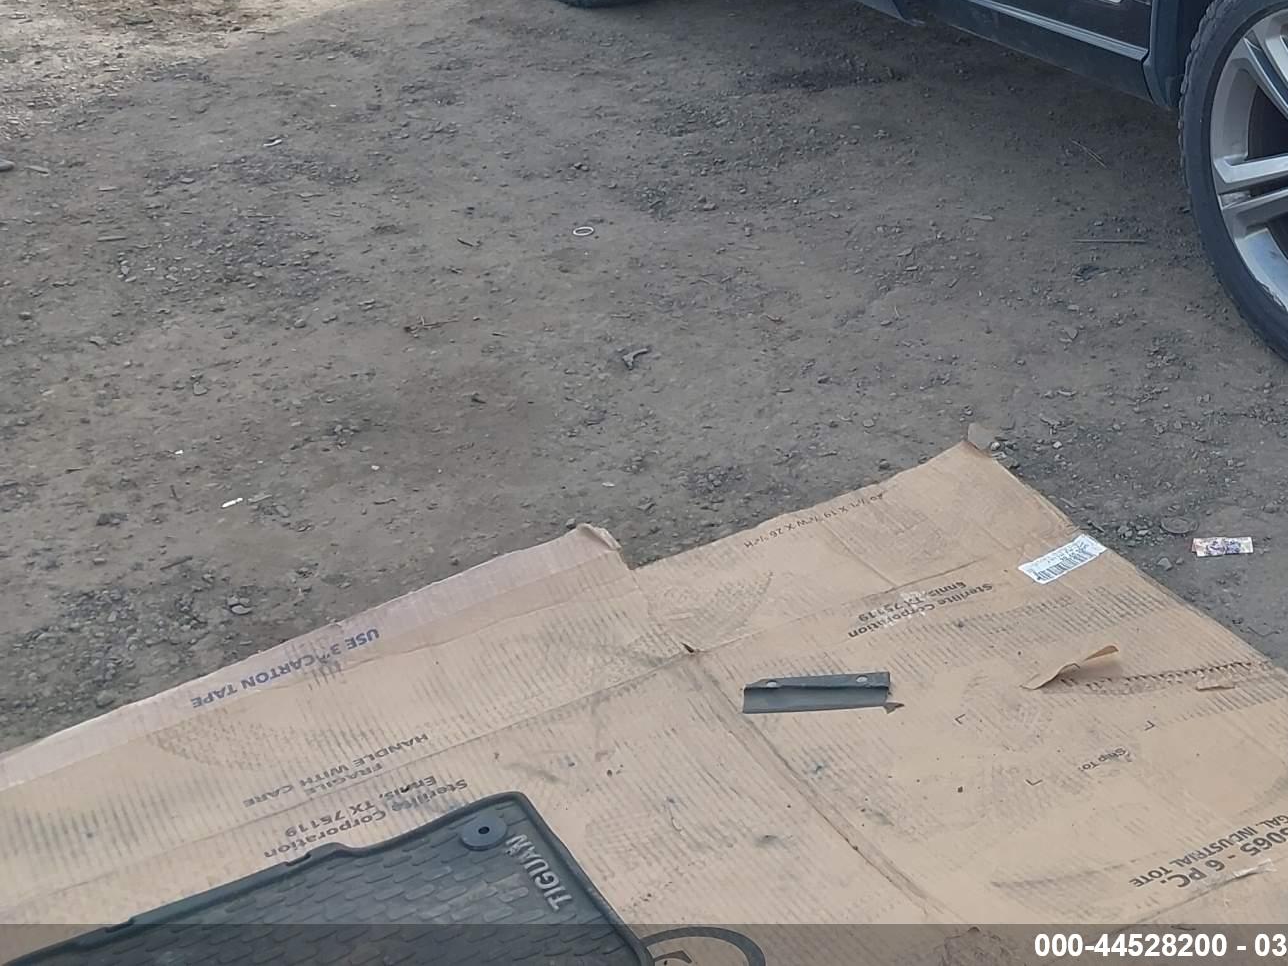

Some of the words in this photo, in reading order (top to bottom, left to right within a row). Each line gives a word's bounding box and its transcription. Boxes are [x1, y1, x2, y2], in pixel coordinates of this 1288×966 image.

[937, 583, 993, 606] Sterilite
[847, 603, 935, 639] Corporation
[857, 601, 902, 622] 75119
[344, 627, 380, 650] USE
[240, 653, 314, 689] CARTON
[189, 682, 237, 709] TAPE
[352, 733, 429, 768] HANDLE
[299, 763, 349, 787] WITH
[304, 763, 383, 796] FRAGILE
[241, 784, 294, 808] CARE
[349, 799, 375, 814] TX
[263, 810, 386, 859] Corporation
[284, 808, 345, 838] 75119
[1169, 826, 1257, 868] INDUSTRIAL
[505, 833, 572, 912] TIGUAN
[1129, 865, 1172, 888] TOTE
[1159, 866, 1207, 888] PC.
[1204, 858, 1225, 872] 6
